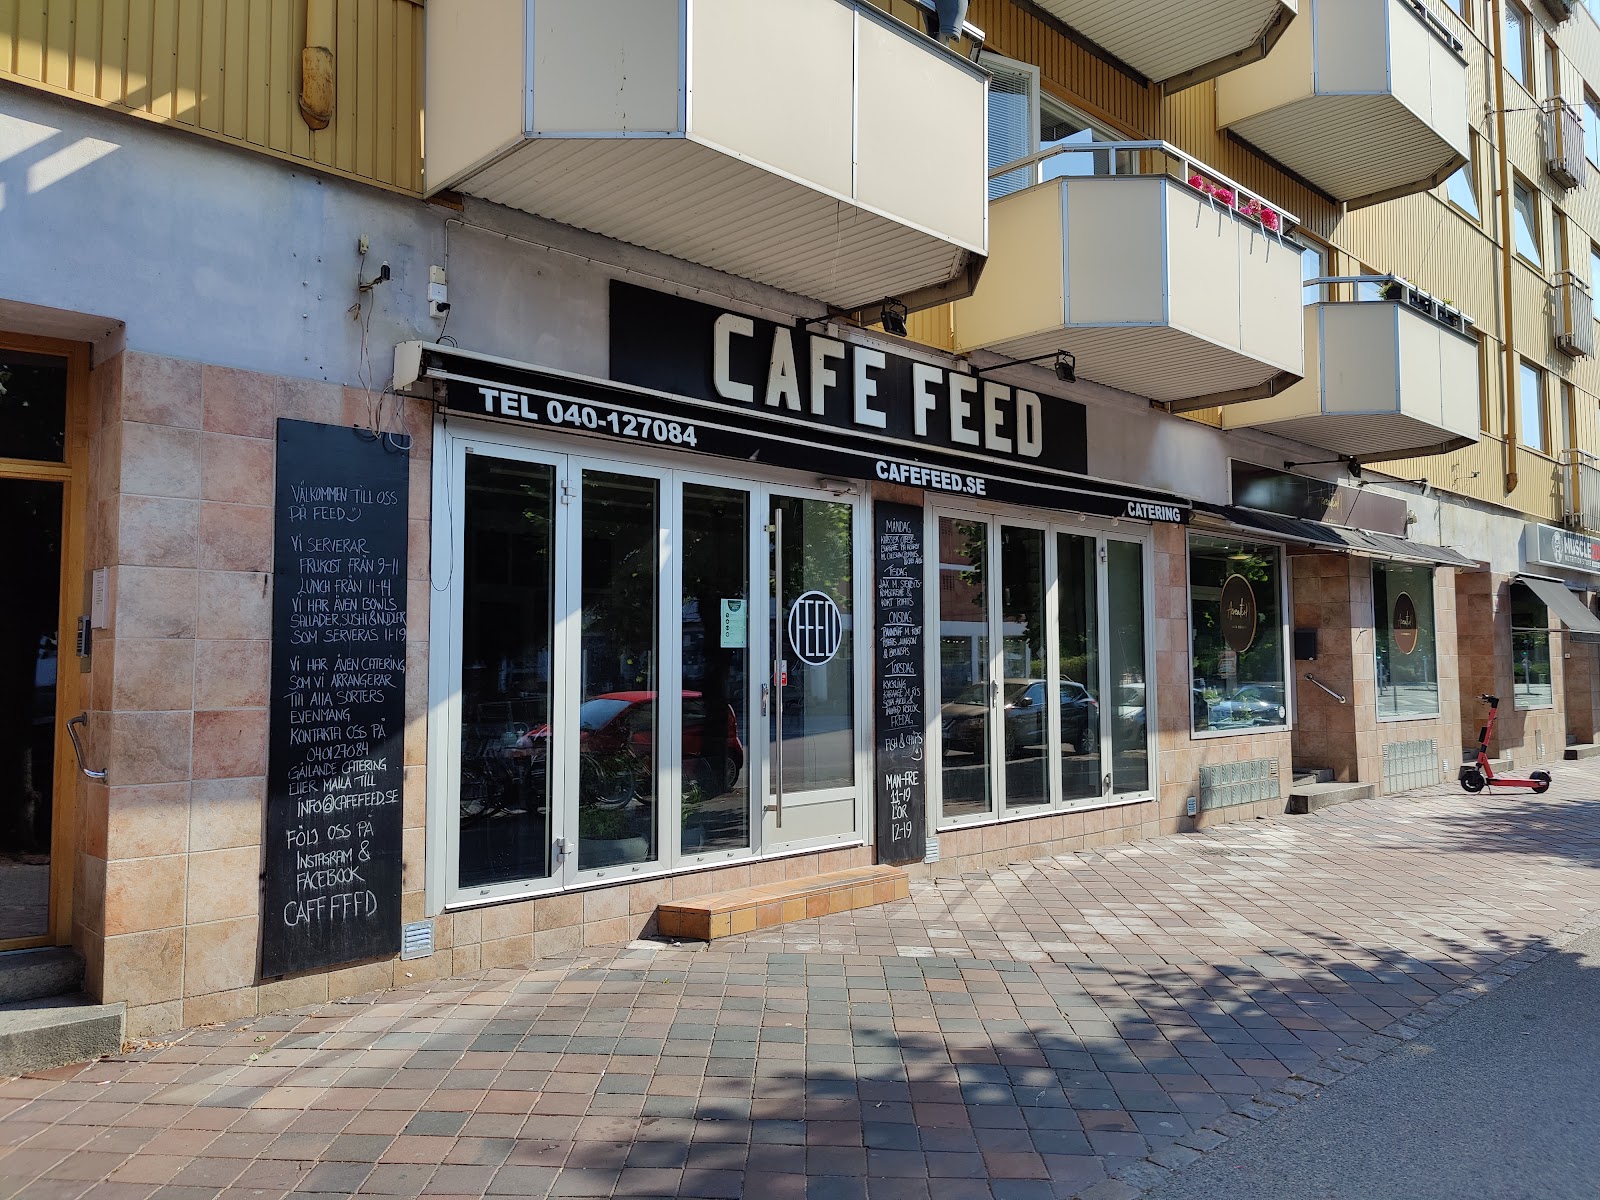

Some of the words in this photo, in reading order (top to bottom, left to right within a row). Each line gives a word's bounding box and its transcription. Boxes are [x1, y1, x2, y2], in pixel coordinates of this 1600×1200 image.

[713, 312, 886, 429] CAFE
[912, 362, 1043, 458] FEED
[479, 387, 538, 420] TEL
[547, 400, 698, 447] 040-127084
[875, 460, 987, 496] CAFEFEED.SE
[290, 480, 348, 503] VÄLKOMMEN
[350, 484, 375, 504] TILL
[376, 490, 398, 506] OSS
[312, 506, 346, 520] FEED
[1127, 502, 1181, 522] CATERING
[885, 517, 912, 533] MÅNDAG
[306, 537, 370, 554] SERVERAR
[1563, 536, 1592, 559] MUSCLE
[299, 557, 342, 574] FRUKOST
[347, 554, 374, 574] FRÅN
[377, 557, 399, 575] 9-11
[884, 563, 908, 577] TISDAG
[297, 577, 331, 595] LUNCH
[334, 575, 363, 594] FRÅN
[307, 598, 330, 612] HAR
[333, 594, 358, 612] ÄVEN
[361, 597, 398, 611] BOWLS
[888, 610, 913, 624] ONSDAG
[290, 629, 318, 645] SOM
[323, 628, 379, 642] SERVERAS
[795, 600, 837, 657] FEED
[307, 658, 329, 671] HAR
[886, 658, 915, 674] TORSDAG
[288, 674, 311, 690] SOM
[330, 673, 397, 688] ARRANGERAR
[336, 689, 385, 704] SORTERS
[290, 707, 351, 724] EVENMANG
[890, 713, 914, 728] FREDAG
[290, 726, 342, 745] KONTAKTA
[345, 724, 368, 739] OSS
[370, 717, 387, 739] PÅ
[306, 741, 369, 761] 040127084
[341, 757, 387, 774] CATERING
[327, 823, 352, 840] OSS
[892, 820, 912, 843] 12-19
[297, 847, 353, 870] INSTAGRAM
[358, 839, 372, 862] &
[296, 865, 366, 892] FACEBOOK
